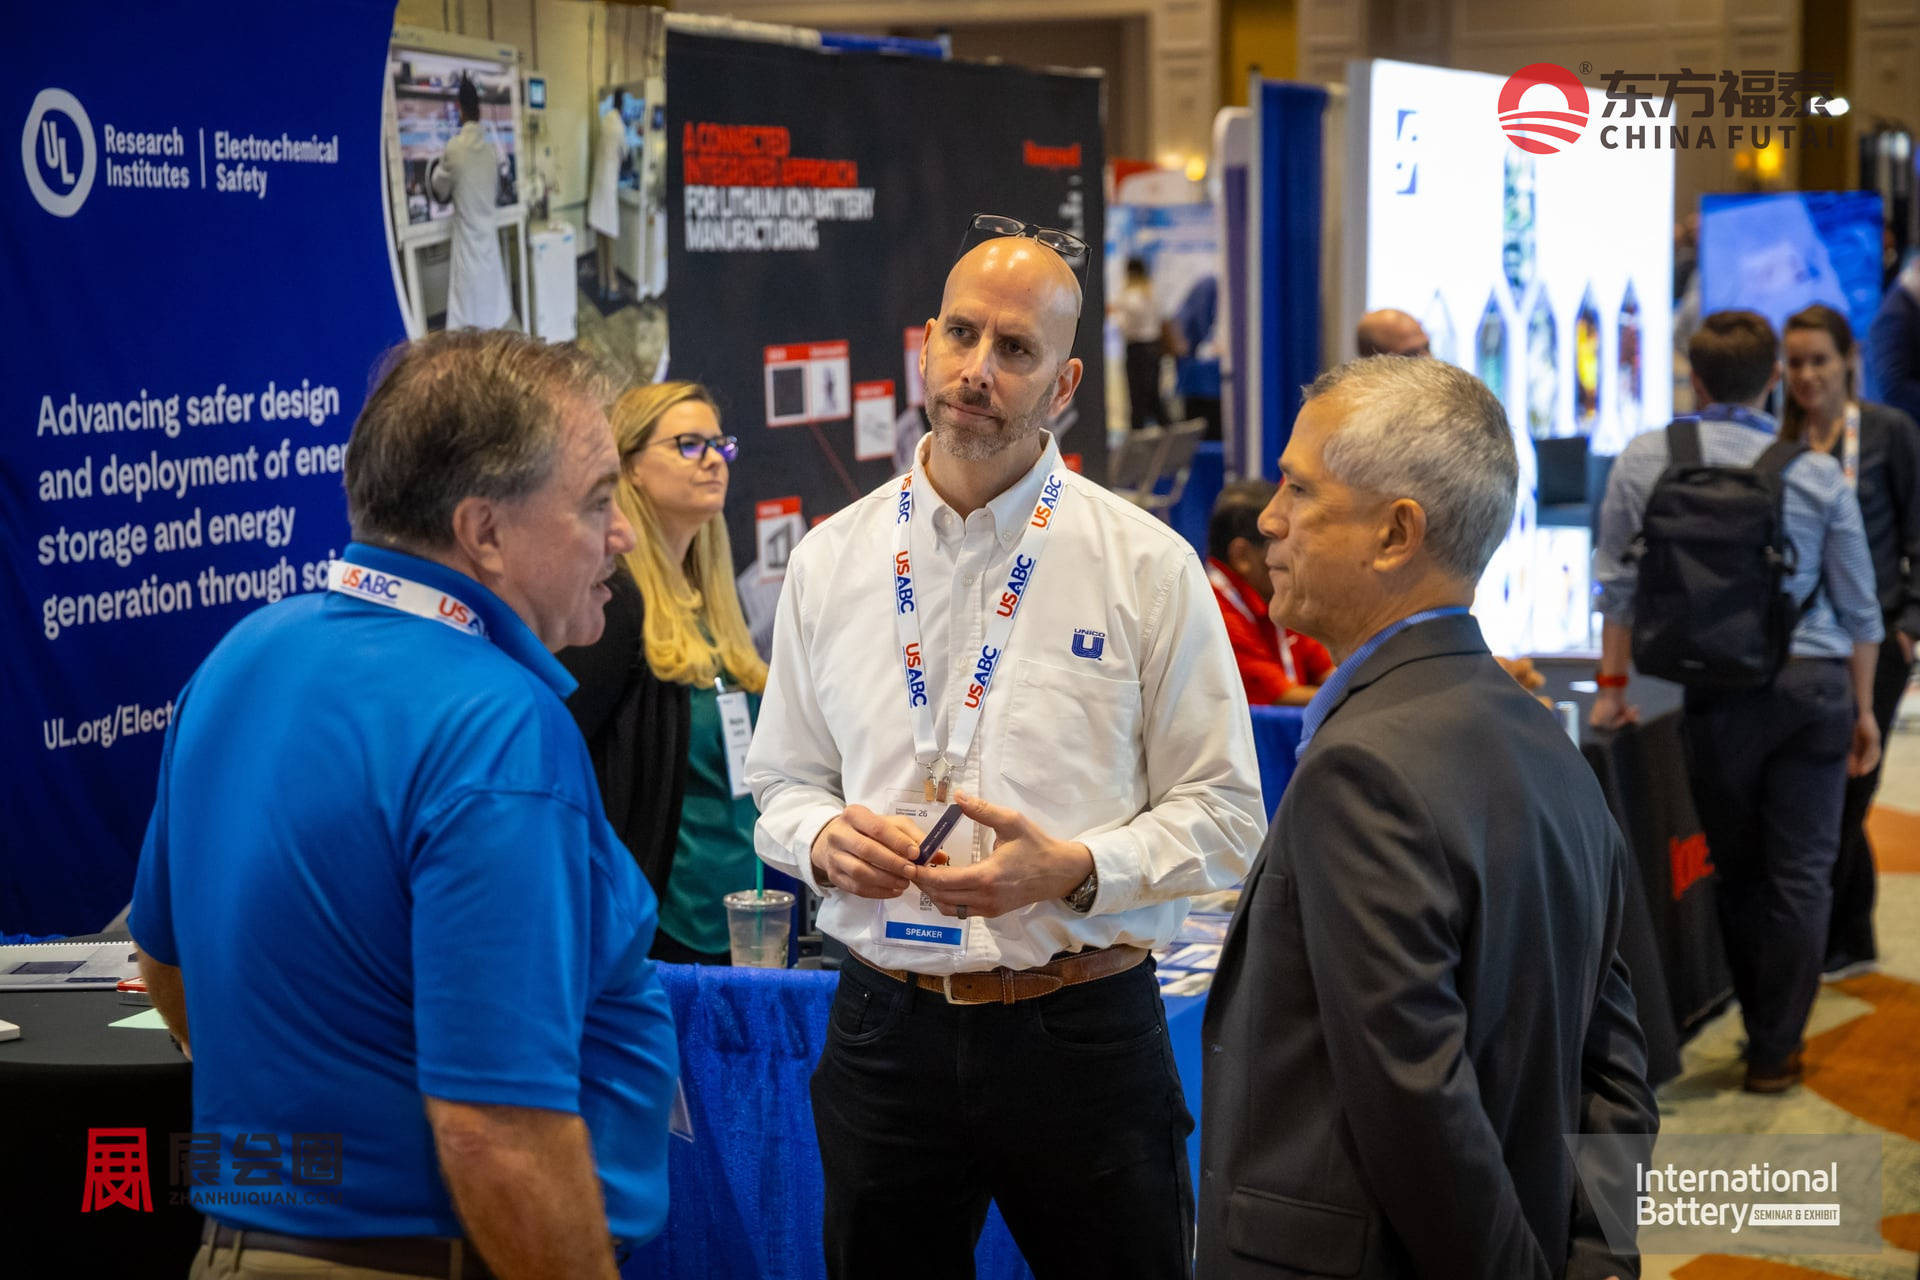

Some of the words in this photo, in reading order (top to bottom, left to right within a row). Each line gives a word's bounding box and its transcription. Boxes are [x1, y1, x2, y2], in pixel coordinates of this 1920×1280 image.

[42, 121, 75, 185] UL
[104, 124, 184, 156] Research
[214, 131, 339, 163] Electrochemical
[106, 158, 190, 189] Institutes
[215, 163, 268, 199] Safety
[813, 187, 876, 221] BATTERY
[685, 219, 820, 251] MANUFACTURING
[37, 388, 180, 438] Advancing
[187, 383, 255, 425] safer
[260, 378, 340, 427] design
[39, 456, 92, 501] and
[100, 445, 258, 502] deployment
[264, 438, 291, 479] of
[1030, 474, 1062, 529] USABC
[38, 523, 148, 567] storage
[154, 508, 201, 552] and
[208, 504, 295, 548] energy
[43, 574, 192, 640] generation
[198, 556, 296, 603] through
[302, 548, 343, 592] sc
[341, 566, 402, 599] USABC
[895, 550, 915, 614] USABC
[996, 553, 1032, 618] USABC
[904, 642, 928, 707] USABC
[964, 645, 997, 709] USABC
[905, 927, 943, 939] SPEAKER
